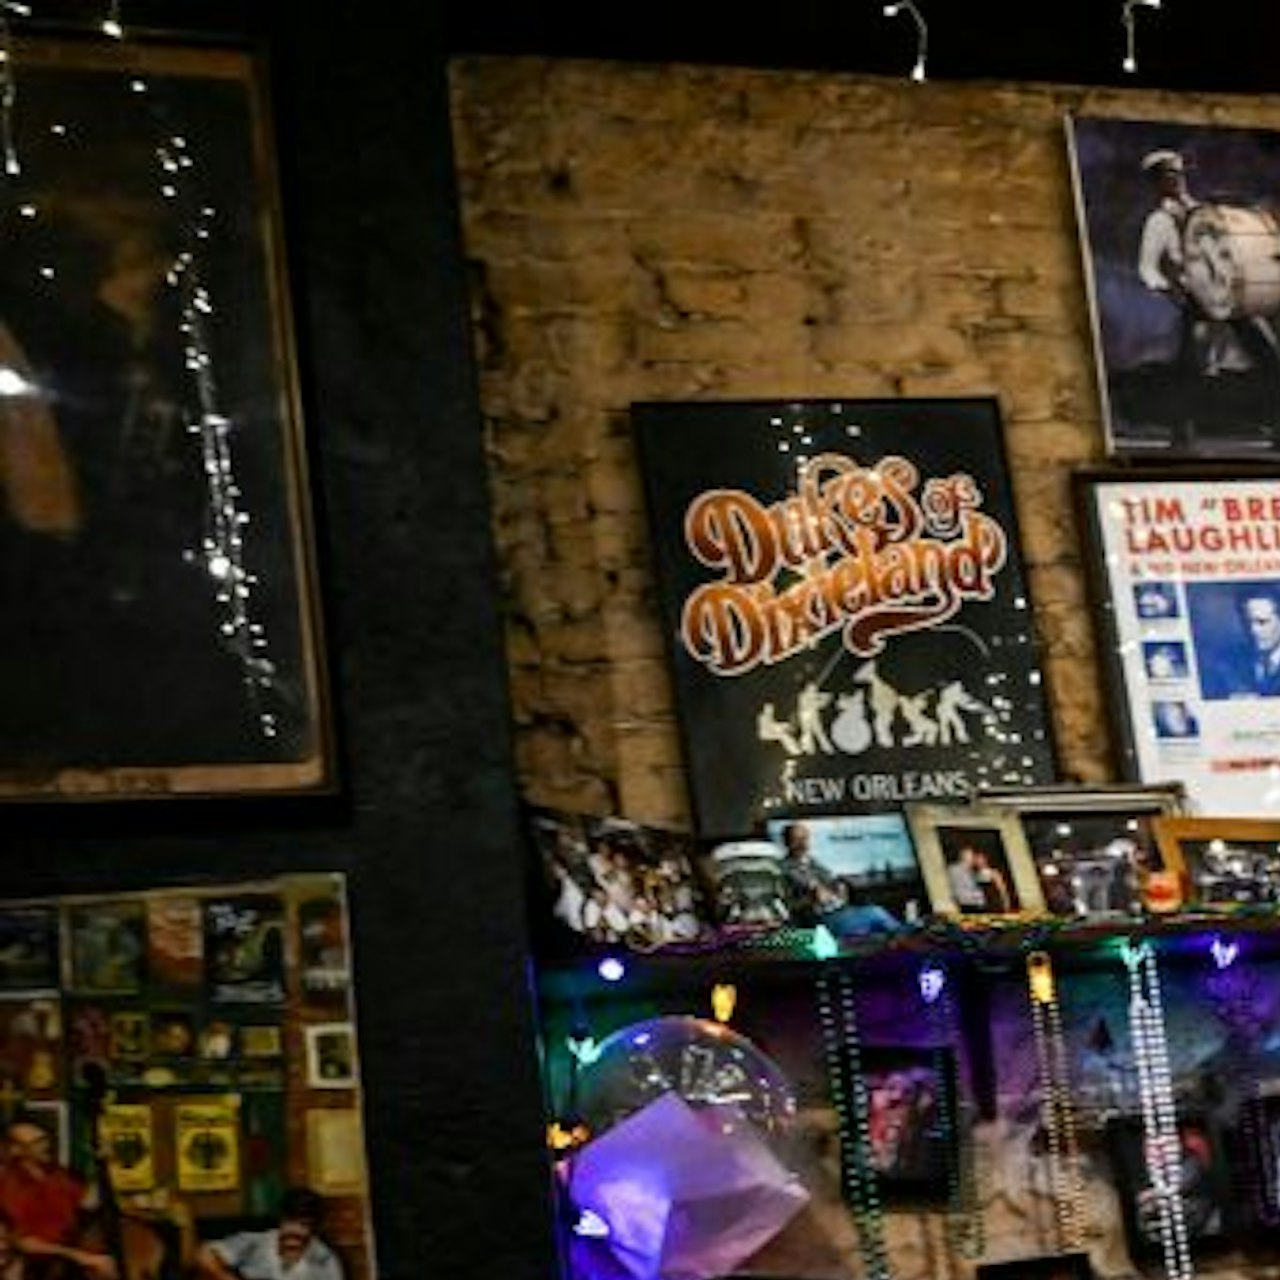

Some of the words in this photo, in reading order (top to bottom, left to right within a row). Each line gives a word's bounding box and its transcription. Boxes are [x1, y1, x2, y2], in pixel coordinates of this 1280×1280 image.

[685, 453, 926, 585] Dukes
[1121, 495, 1186, 525] TIM
[681, 511, 1006, 677] Dixieland
[786, 777, 845, 803] NEW
[852, 769, 973, 801] ORLEANS
